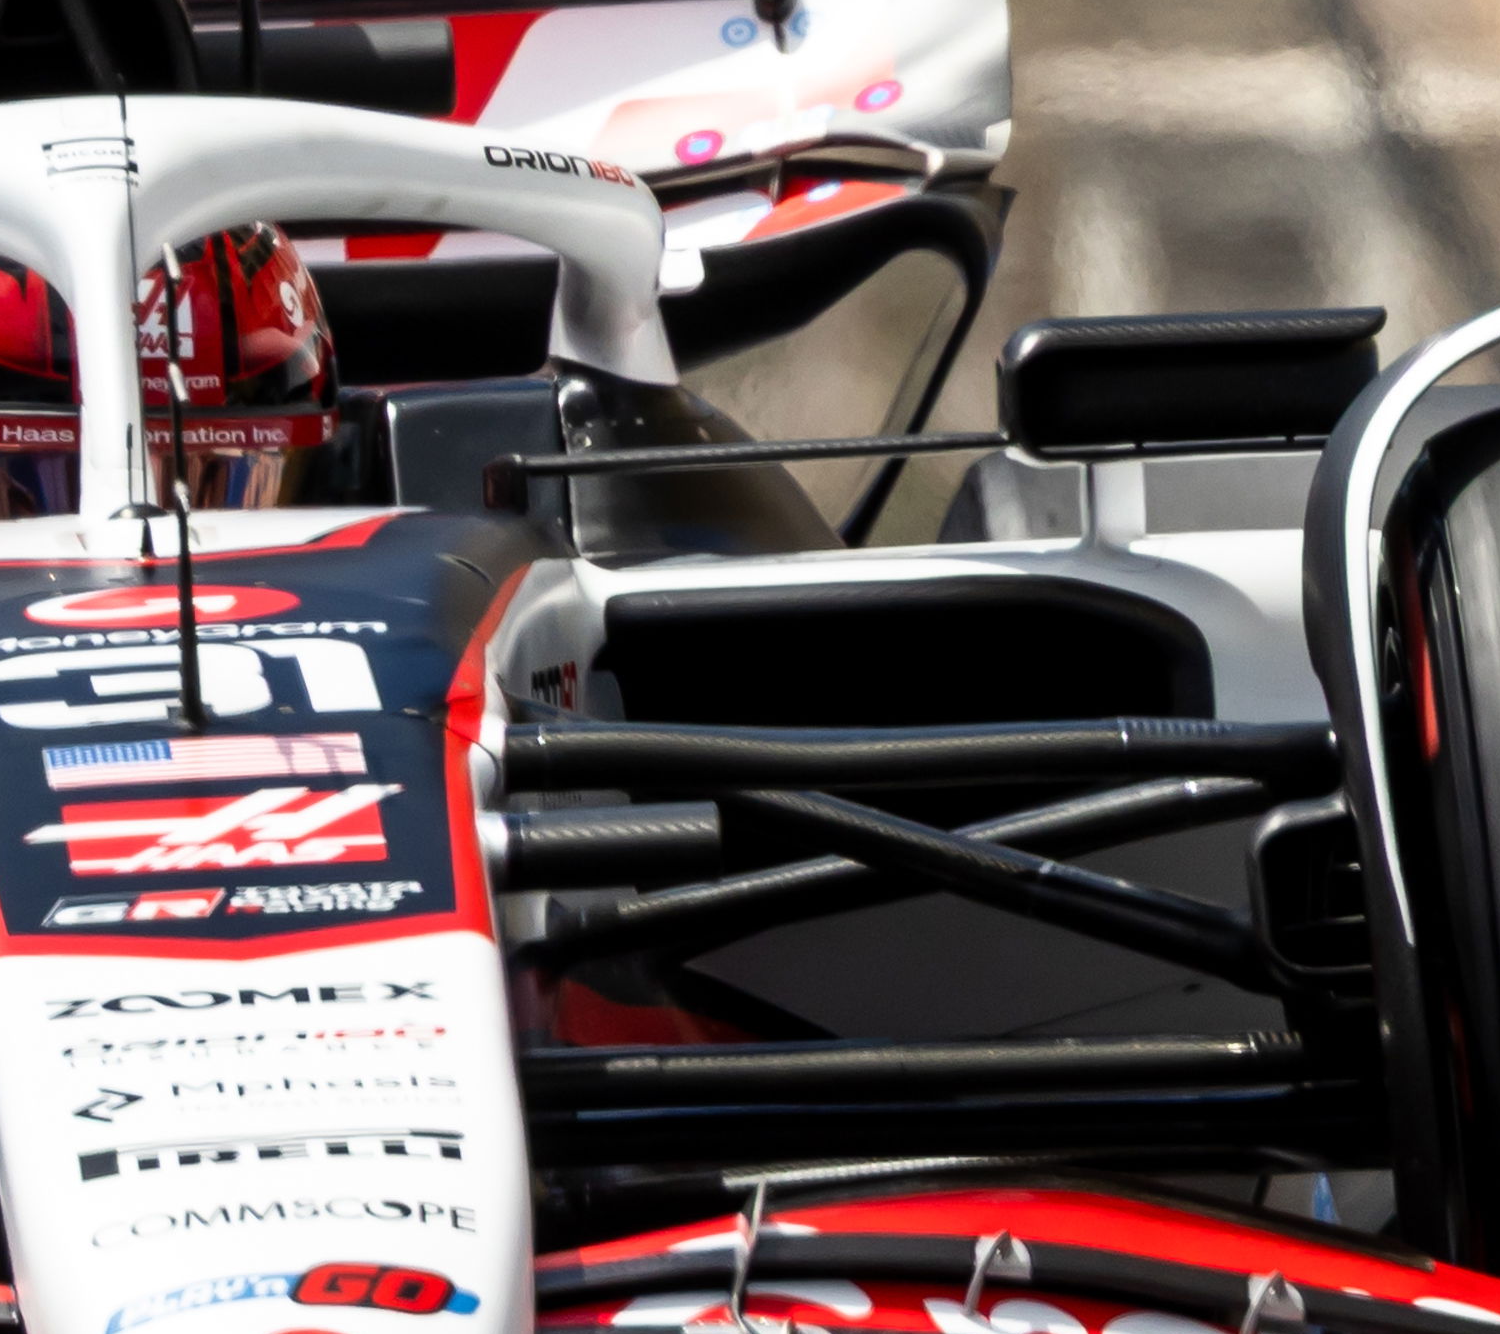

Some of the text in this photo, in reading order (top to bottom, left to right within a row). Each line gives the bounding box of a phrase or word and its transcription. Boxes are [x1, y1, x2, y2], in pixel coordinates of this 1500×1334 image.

[484, 145, 635, 188] ORION180
[2, 424, 75, 443] Haas
[77, 1129, 465, 1181] PIRELLI
[91, 1199, 478, 1248] COMMSCOPE
[290, 1261, 458, 1315] GO
